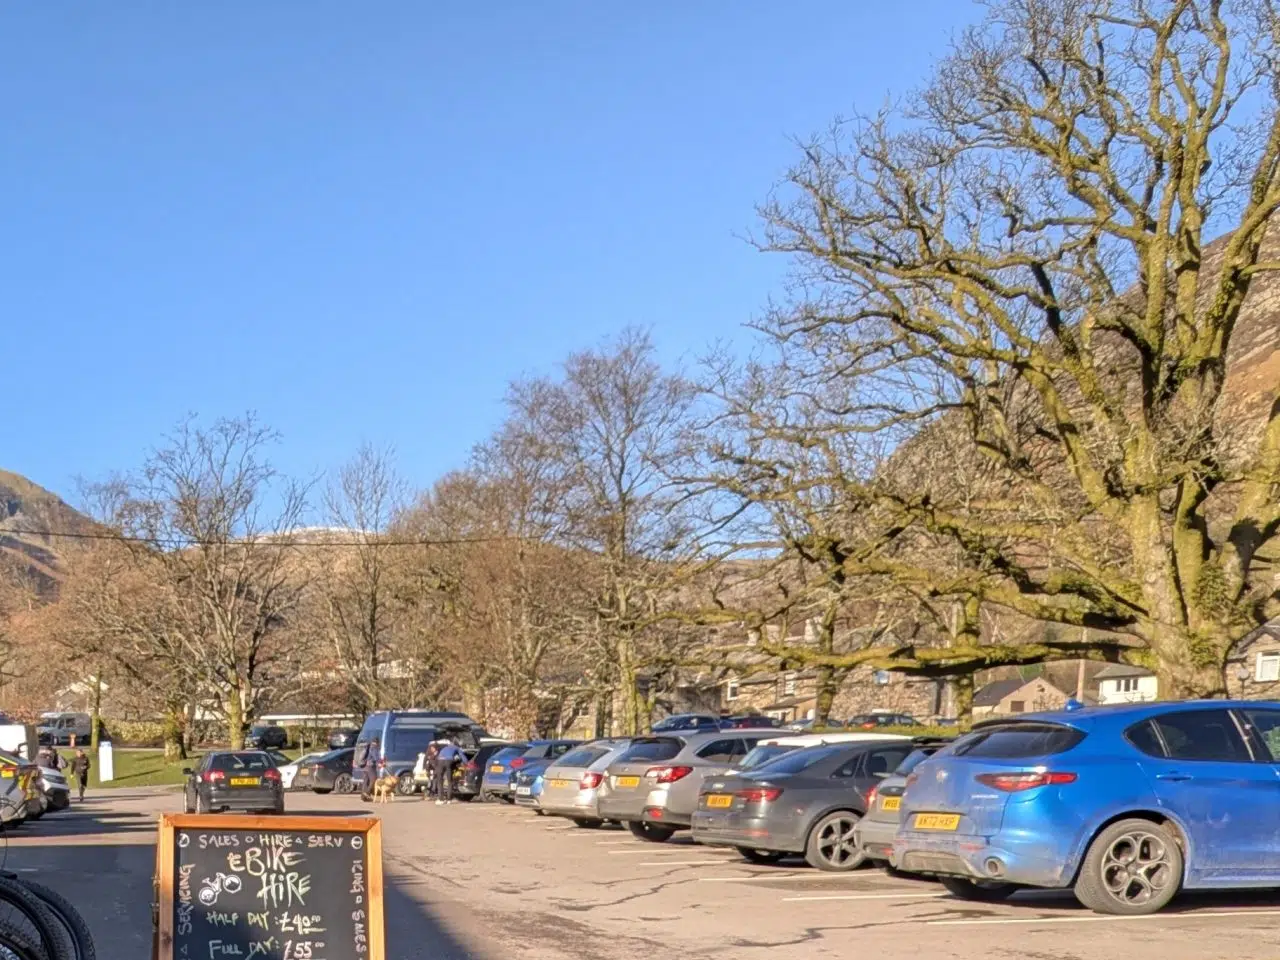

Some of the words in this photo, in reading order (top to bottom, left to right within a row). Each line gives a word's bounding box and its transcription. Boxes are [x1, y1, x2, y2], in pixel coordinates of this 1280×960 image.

[198, 834, 240, 849] SALES
[259, 834, 293, 848] HIRE
[308, 834, 344, 848] SERV
[206, 911, 239, 926] HALF
